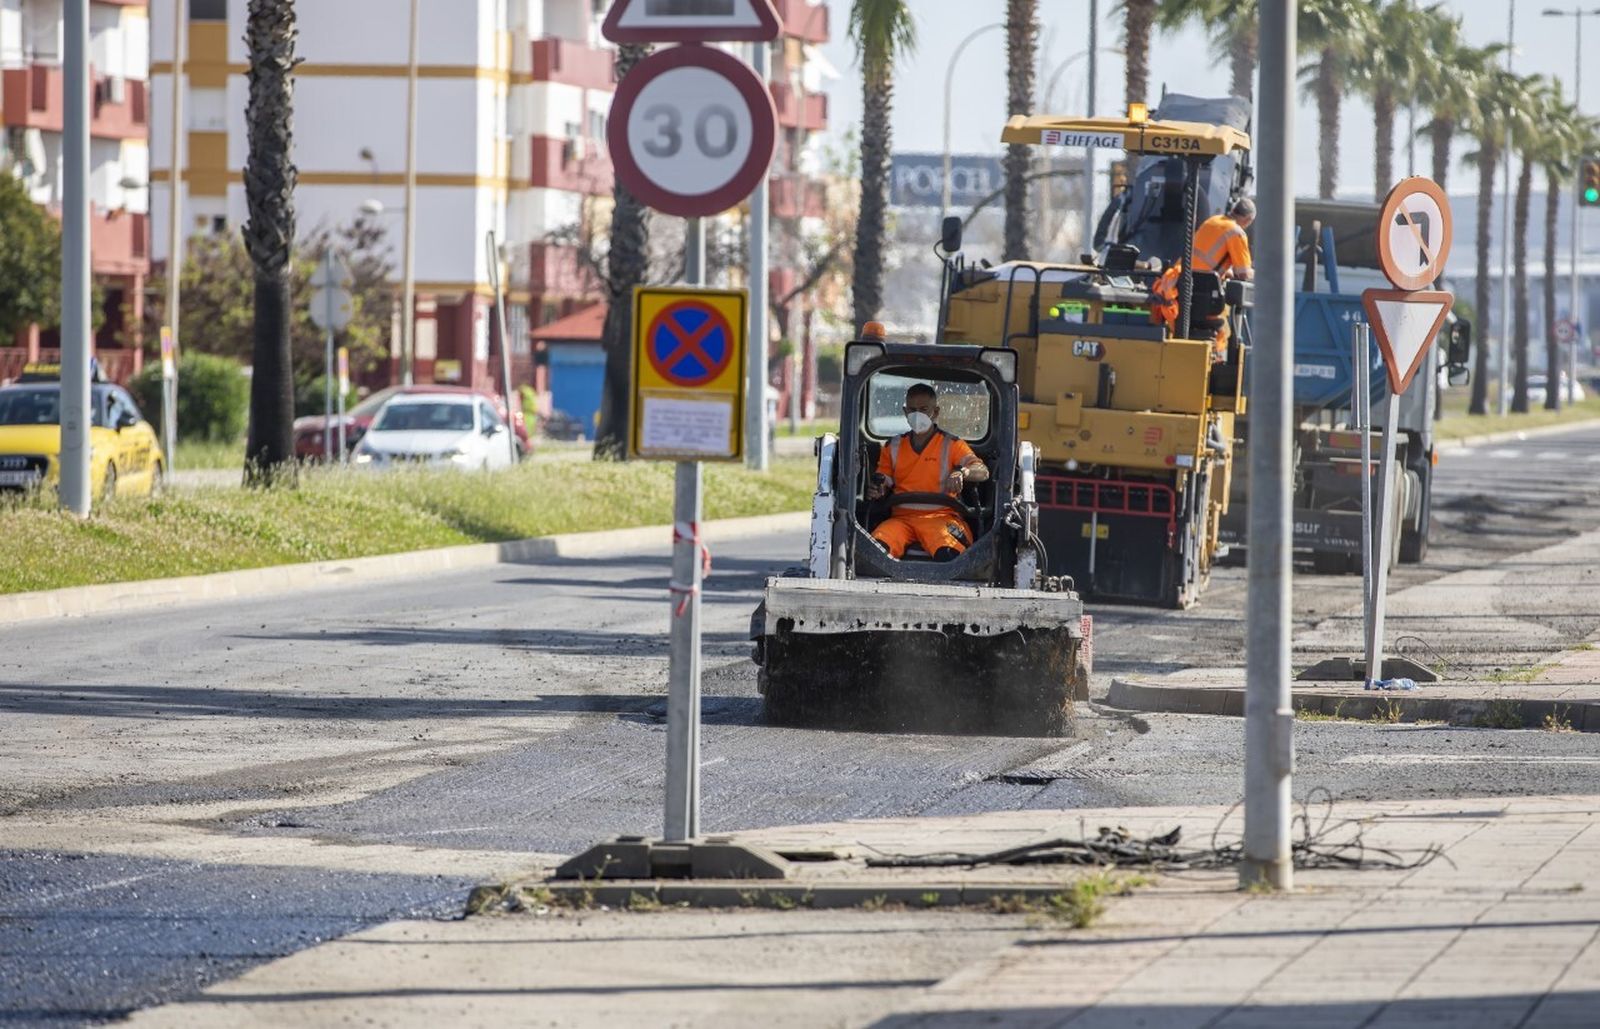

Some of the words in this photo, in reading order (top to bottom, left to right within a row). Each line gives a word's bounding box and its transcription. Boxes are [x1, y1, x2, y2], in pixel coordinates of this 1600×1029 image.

[641, 102, 739, 159] 30
[1064, 134, 1120, 148] EIFFAGE
[1151, 136, 1201, 151] C313A
[1072, 340, 1100, 357] CAT
[1293, 521, 1321, 535] sur
